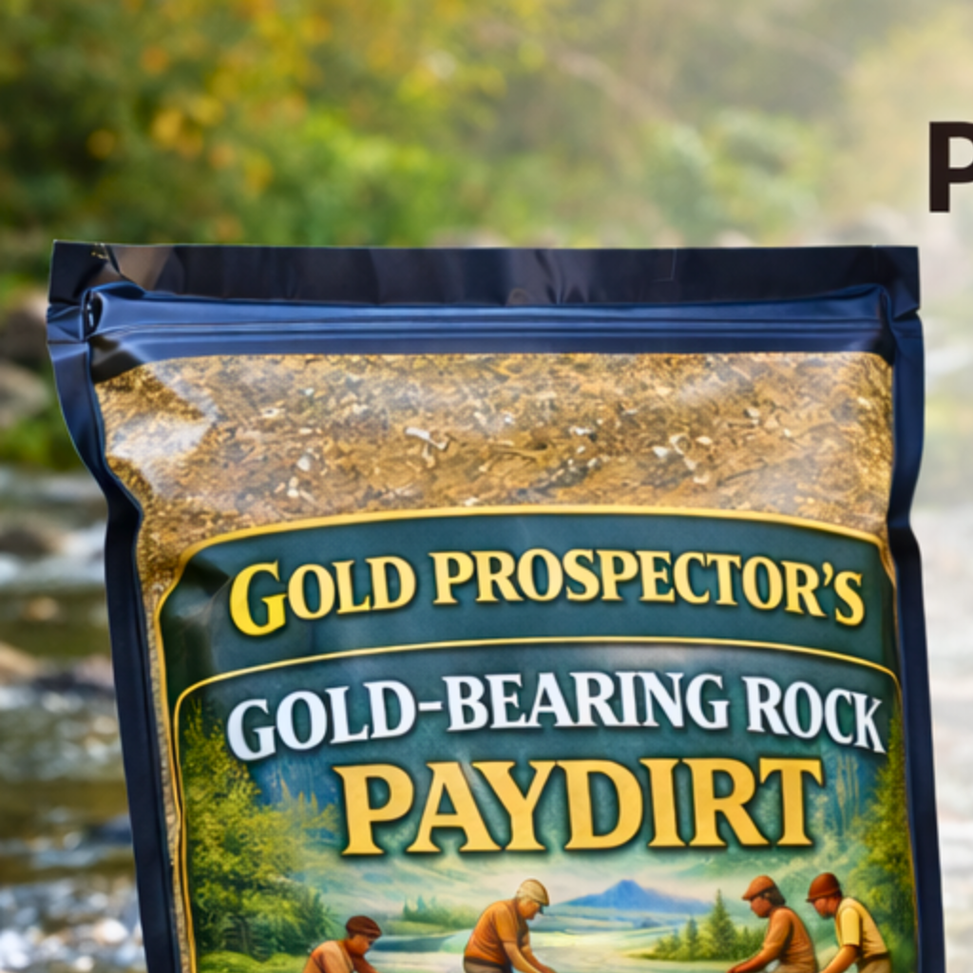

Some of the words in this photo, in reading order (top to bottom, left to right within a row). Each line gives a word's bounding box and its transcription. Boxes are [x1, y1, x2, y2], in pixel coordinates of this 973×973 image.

[229, 554, 417, 637] GOLD
[430, 548, 866, 626] PROSPECTOR’S
[226, 671, 729, 762] GOLD-BEARING
[740, 677, 886, 754] ROCK
[333, 757, 823, 856] PAYDIRT
